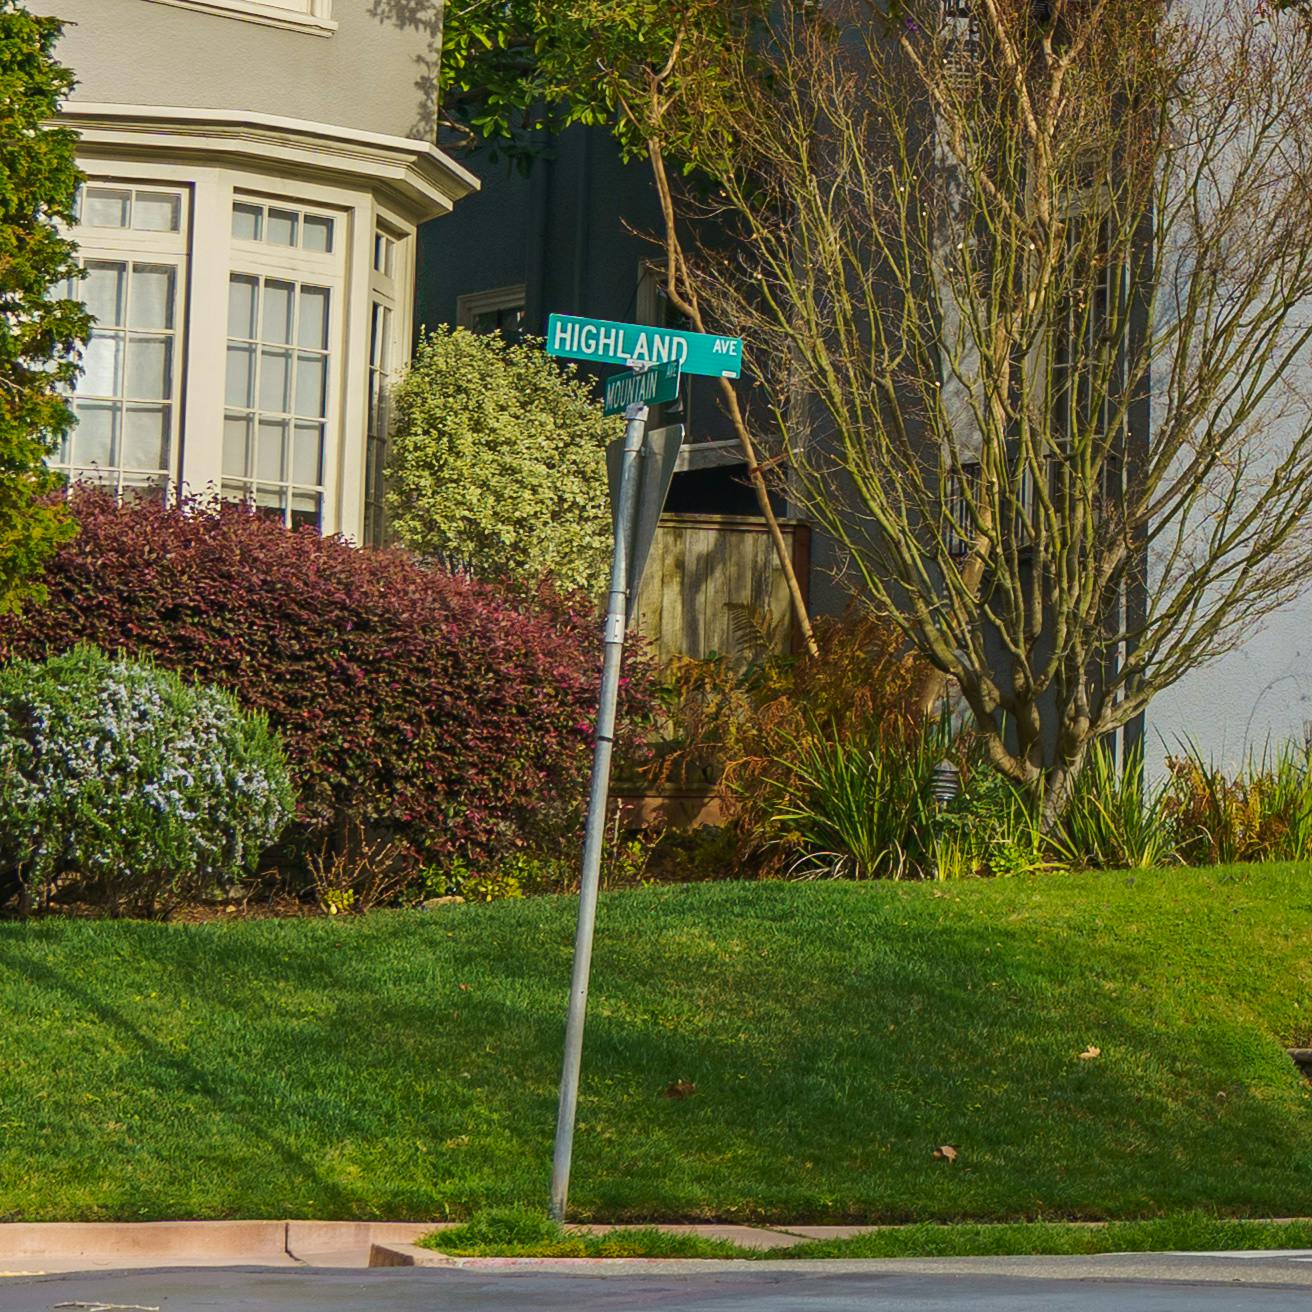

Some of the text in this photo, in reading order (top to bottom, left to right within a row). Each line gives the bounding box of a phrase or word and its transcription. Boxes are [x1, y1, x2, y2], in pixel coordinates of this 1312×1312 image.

[554, 321, 738, 365] HIGHLAND AVE
[605, 370, 658, 411] MOUNTAIN
